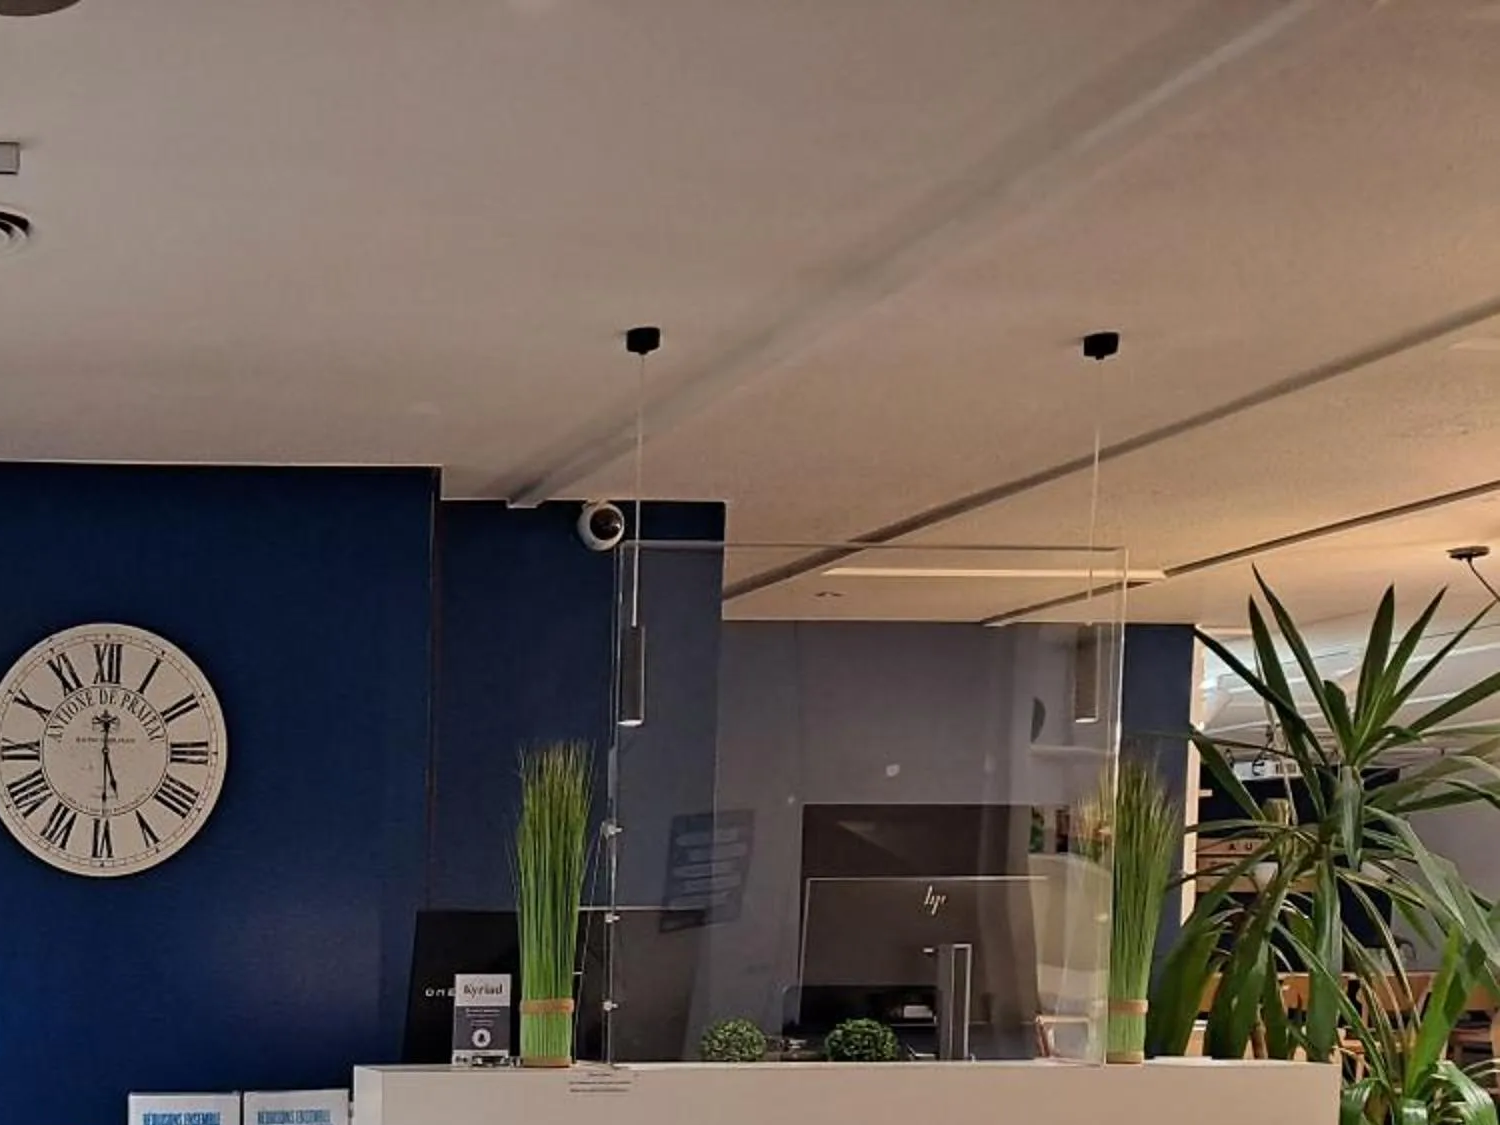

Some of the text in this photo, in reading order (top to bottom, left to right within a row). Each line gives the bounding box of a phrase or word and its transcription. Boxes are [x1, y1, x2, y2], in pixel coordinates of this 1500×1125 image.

[93, 643, 123, 684] XII
[924, 885, 947, 916] hp
[463, 983, 503, 999] Kyriad
